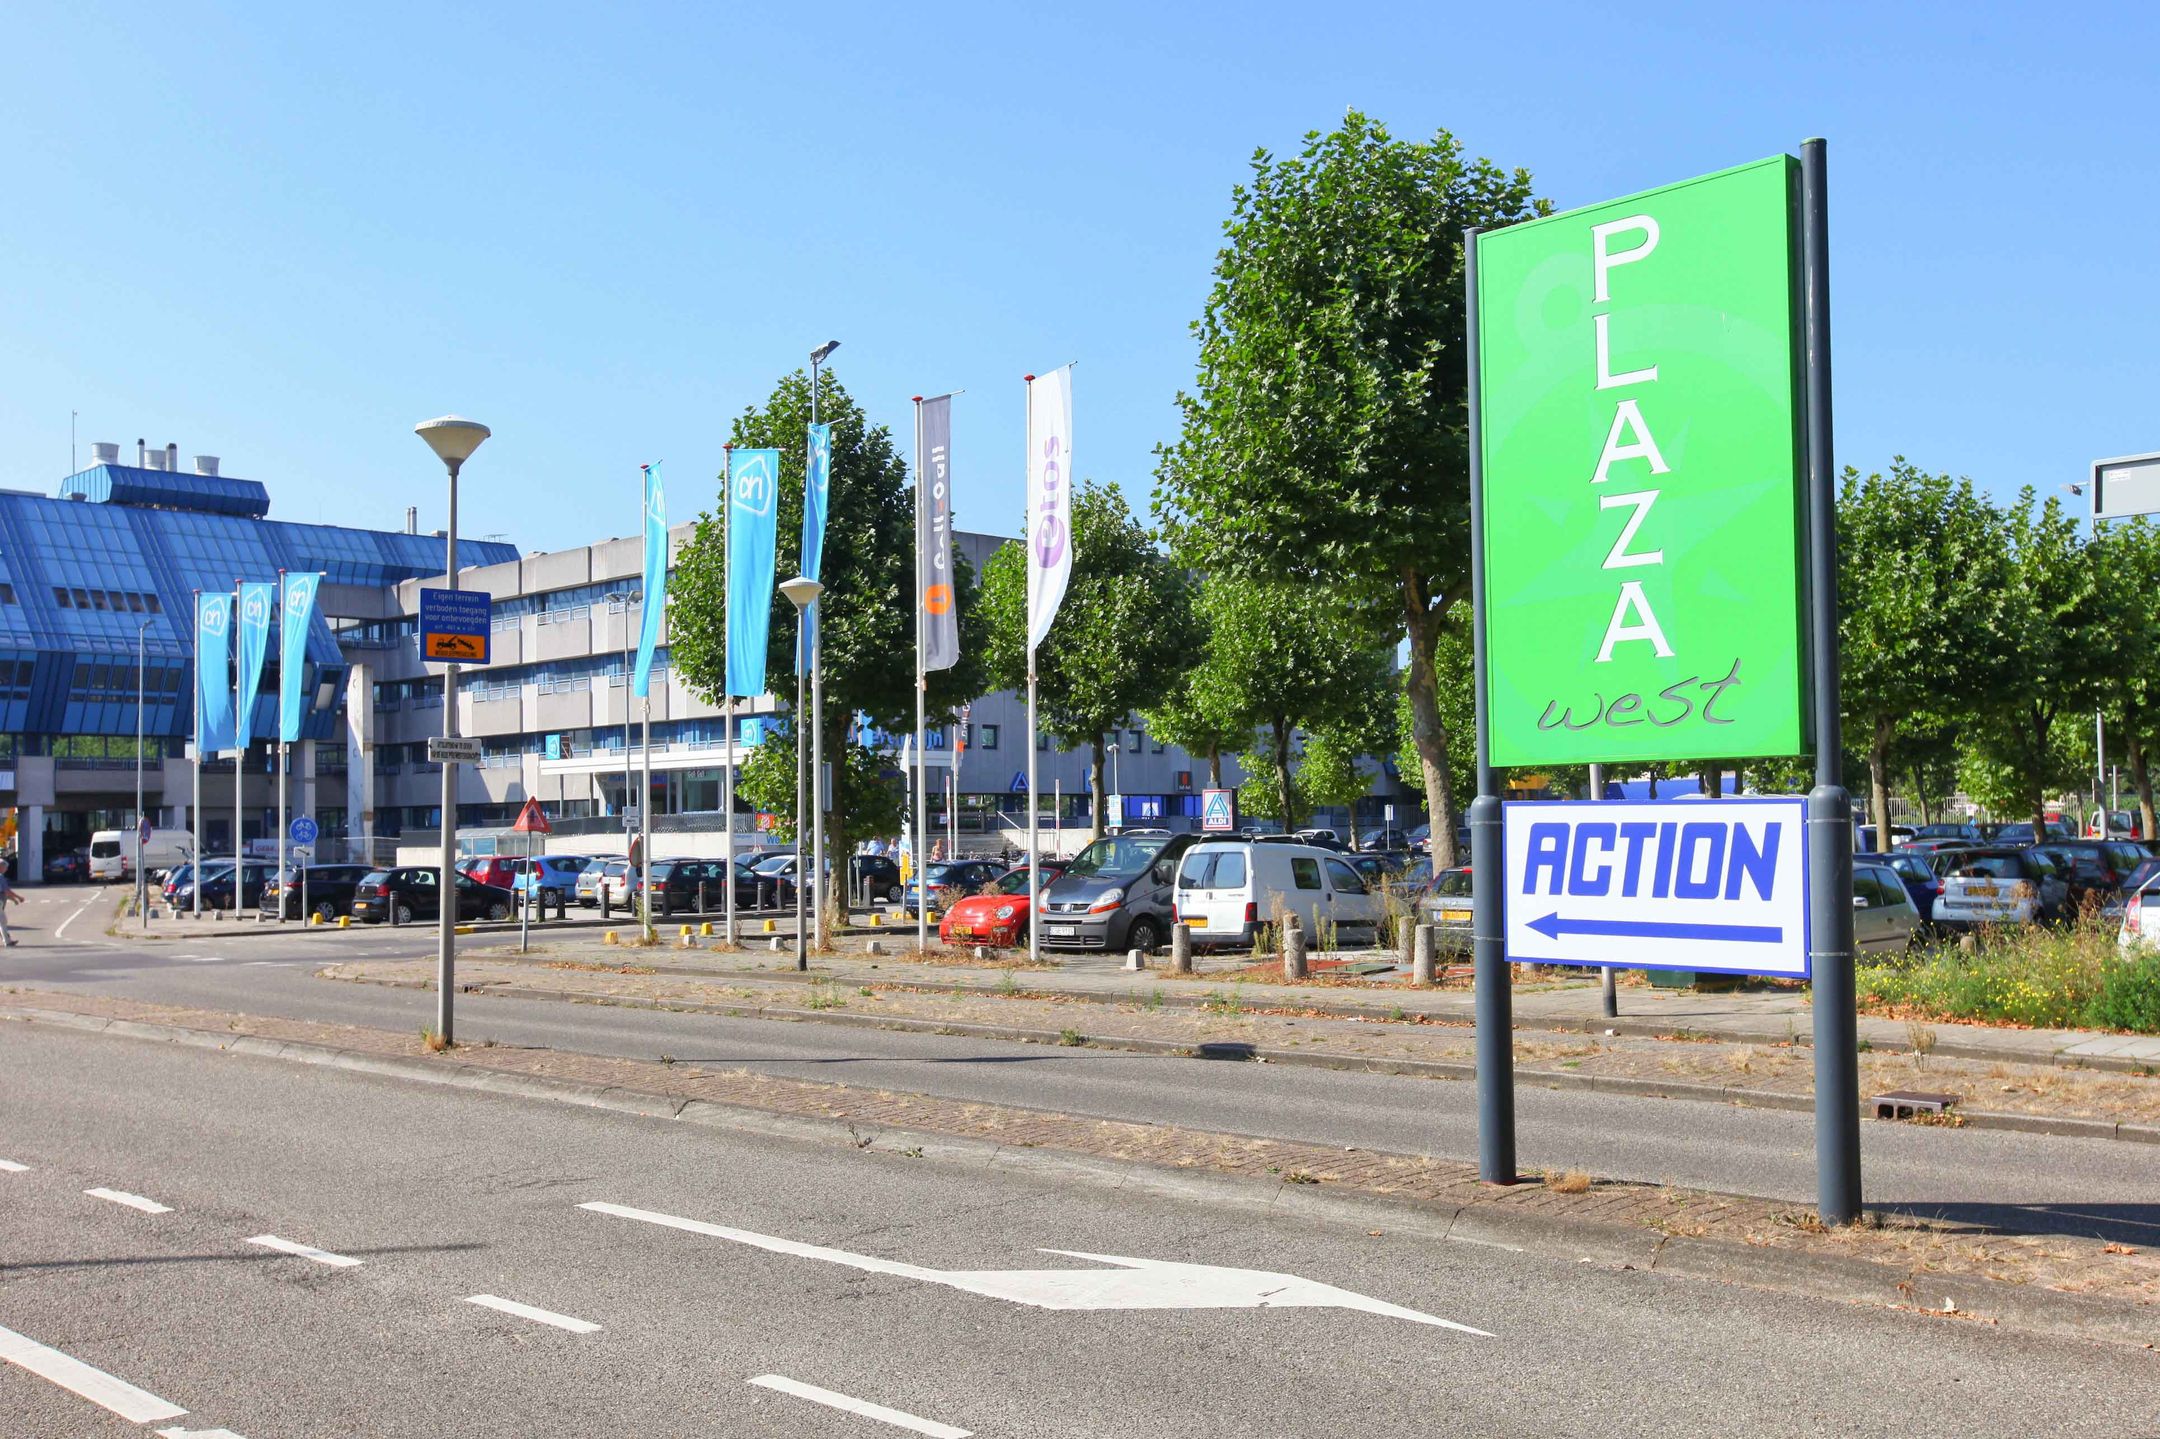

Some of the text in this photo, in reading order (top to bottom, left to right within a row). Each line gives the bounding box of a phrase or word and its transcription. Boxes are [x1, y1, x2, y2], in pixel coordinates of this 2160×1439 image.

[1590, 213, 1675, 663] PLAZA
[1538, 657, 1742, 730] west
[1522, 821, 1782, 902] ACTION
